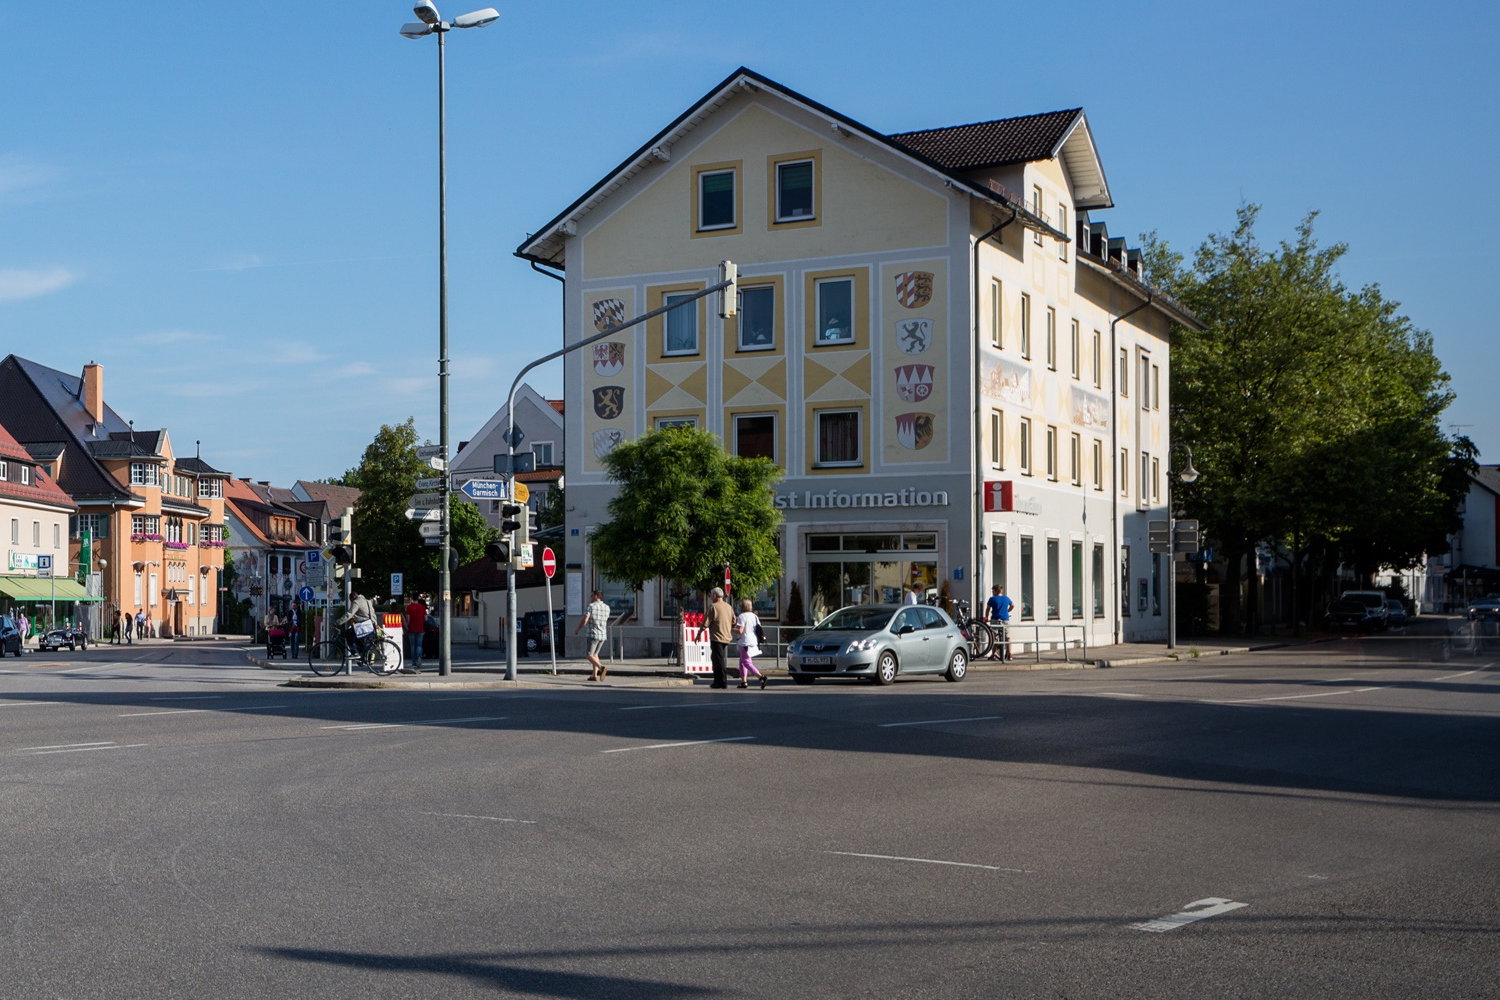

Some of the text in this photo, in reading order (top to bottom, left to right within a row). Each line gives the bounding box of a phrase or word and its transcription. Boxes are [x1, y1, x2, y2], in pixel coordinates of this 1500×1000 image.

[471, 481, 498, 489] München-
[472, 488, 498, 497] Garmisch
[805, 487, 947, 509] Information
